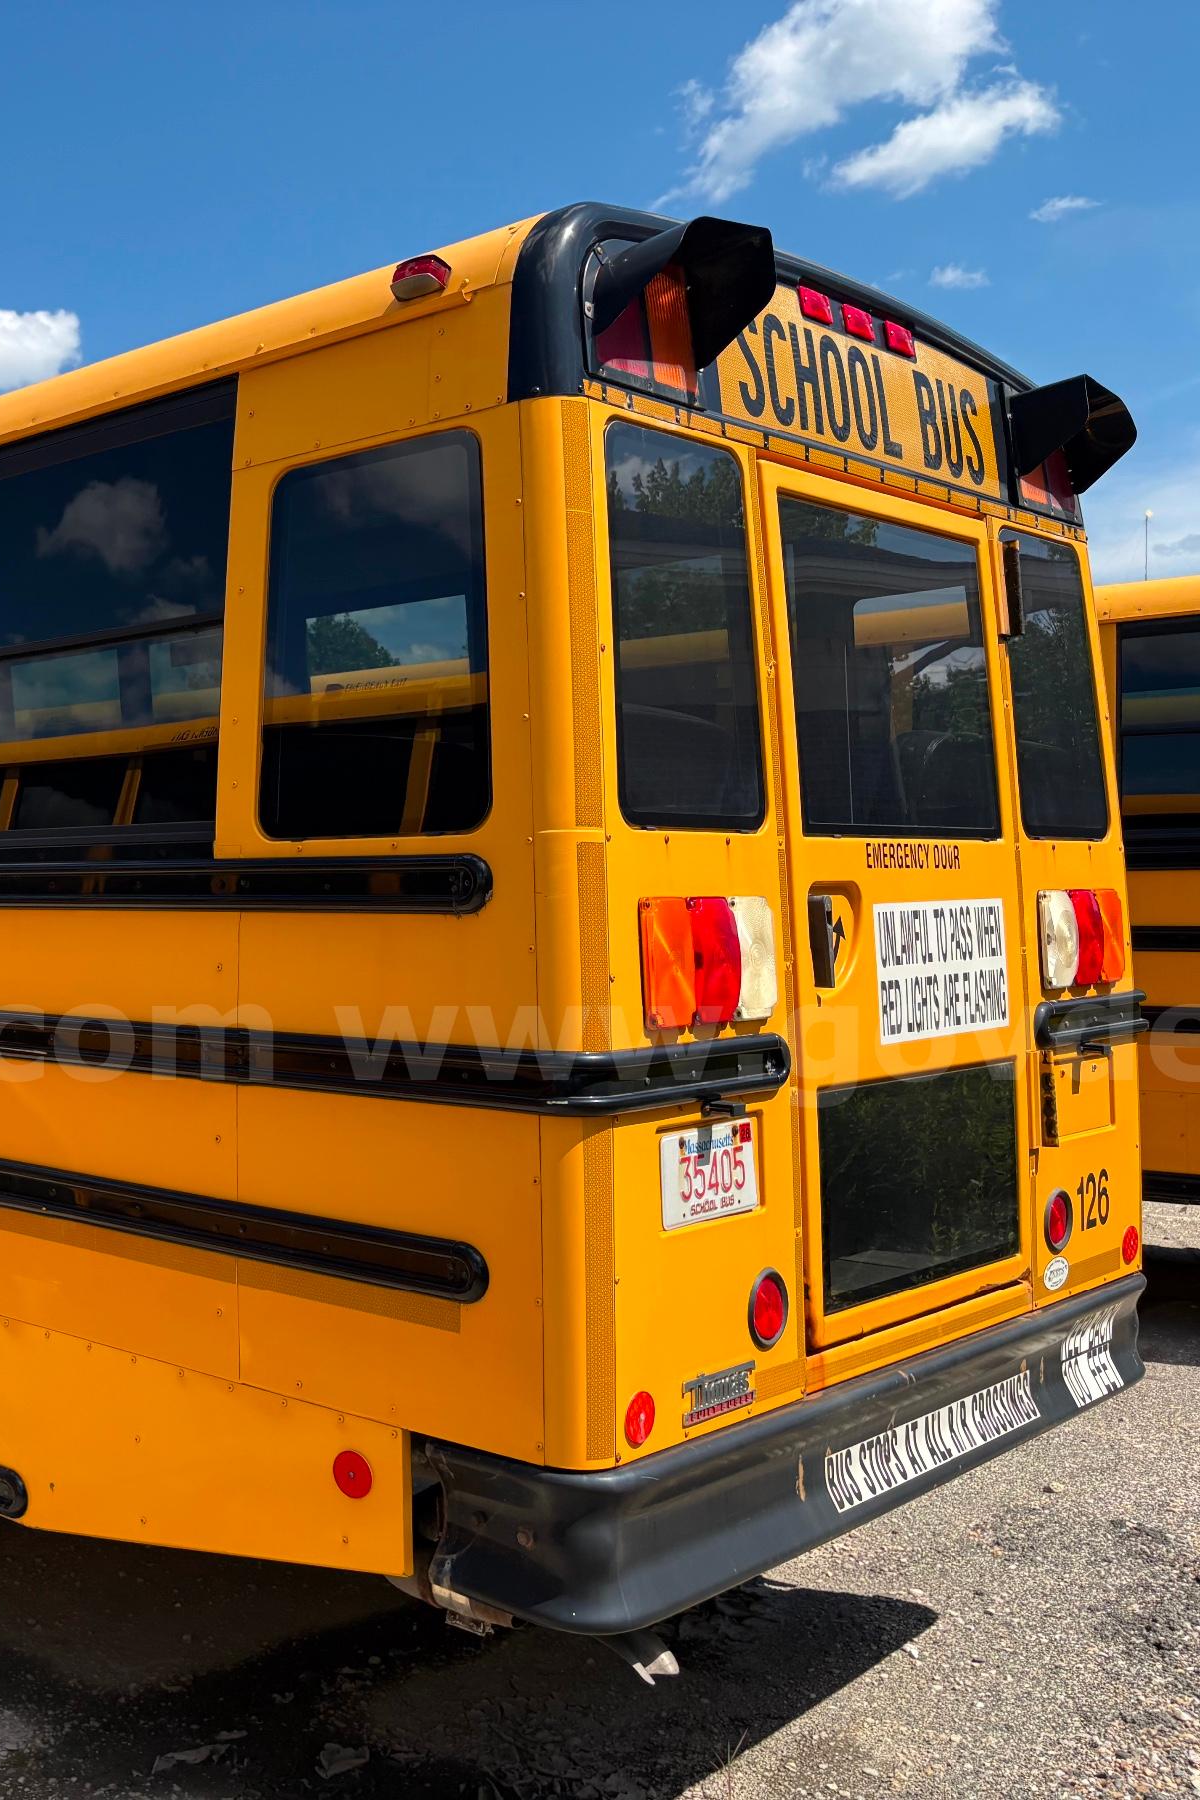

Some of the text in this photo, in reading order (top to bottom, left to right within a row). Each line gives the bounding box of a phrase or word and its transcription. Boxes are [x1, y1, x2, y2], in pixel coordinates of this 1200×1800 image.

[737, 313, 985, 486] SCHOOL BUS
[865, 842, 961, 870] EMERGENCY DOOR
[877, 905, 1003, 969] UNLAWFUL TO PASS WHEN
[880, 967, 1007, 1037] RED LIGHTS ARE FLASHING
[679, 1145, 745, 1203] 35405
[690, 1194, 735, 1217] SCHOOL BUS
[1077, 1168, 1110, 1231] 126
[826, 1449, 863, 1510] BUS
[858, 1429, 908, 1496] STOPS
[904, 1420, 928, 1475] AT
[924, 1410, 952, 1466] ALL
[971, 1372, 1038, 1443] CROSSINGS
